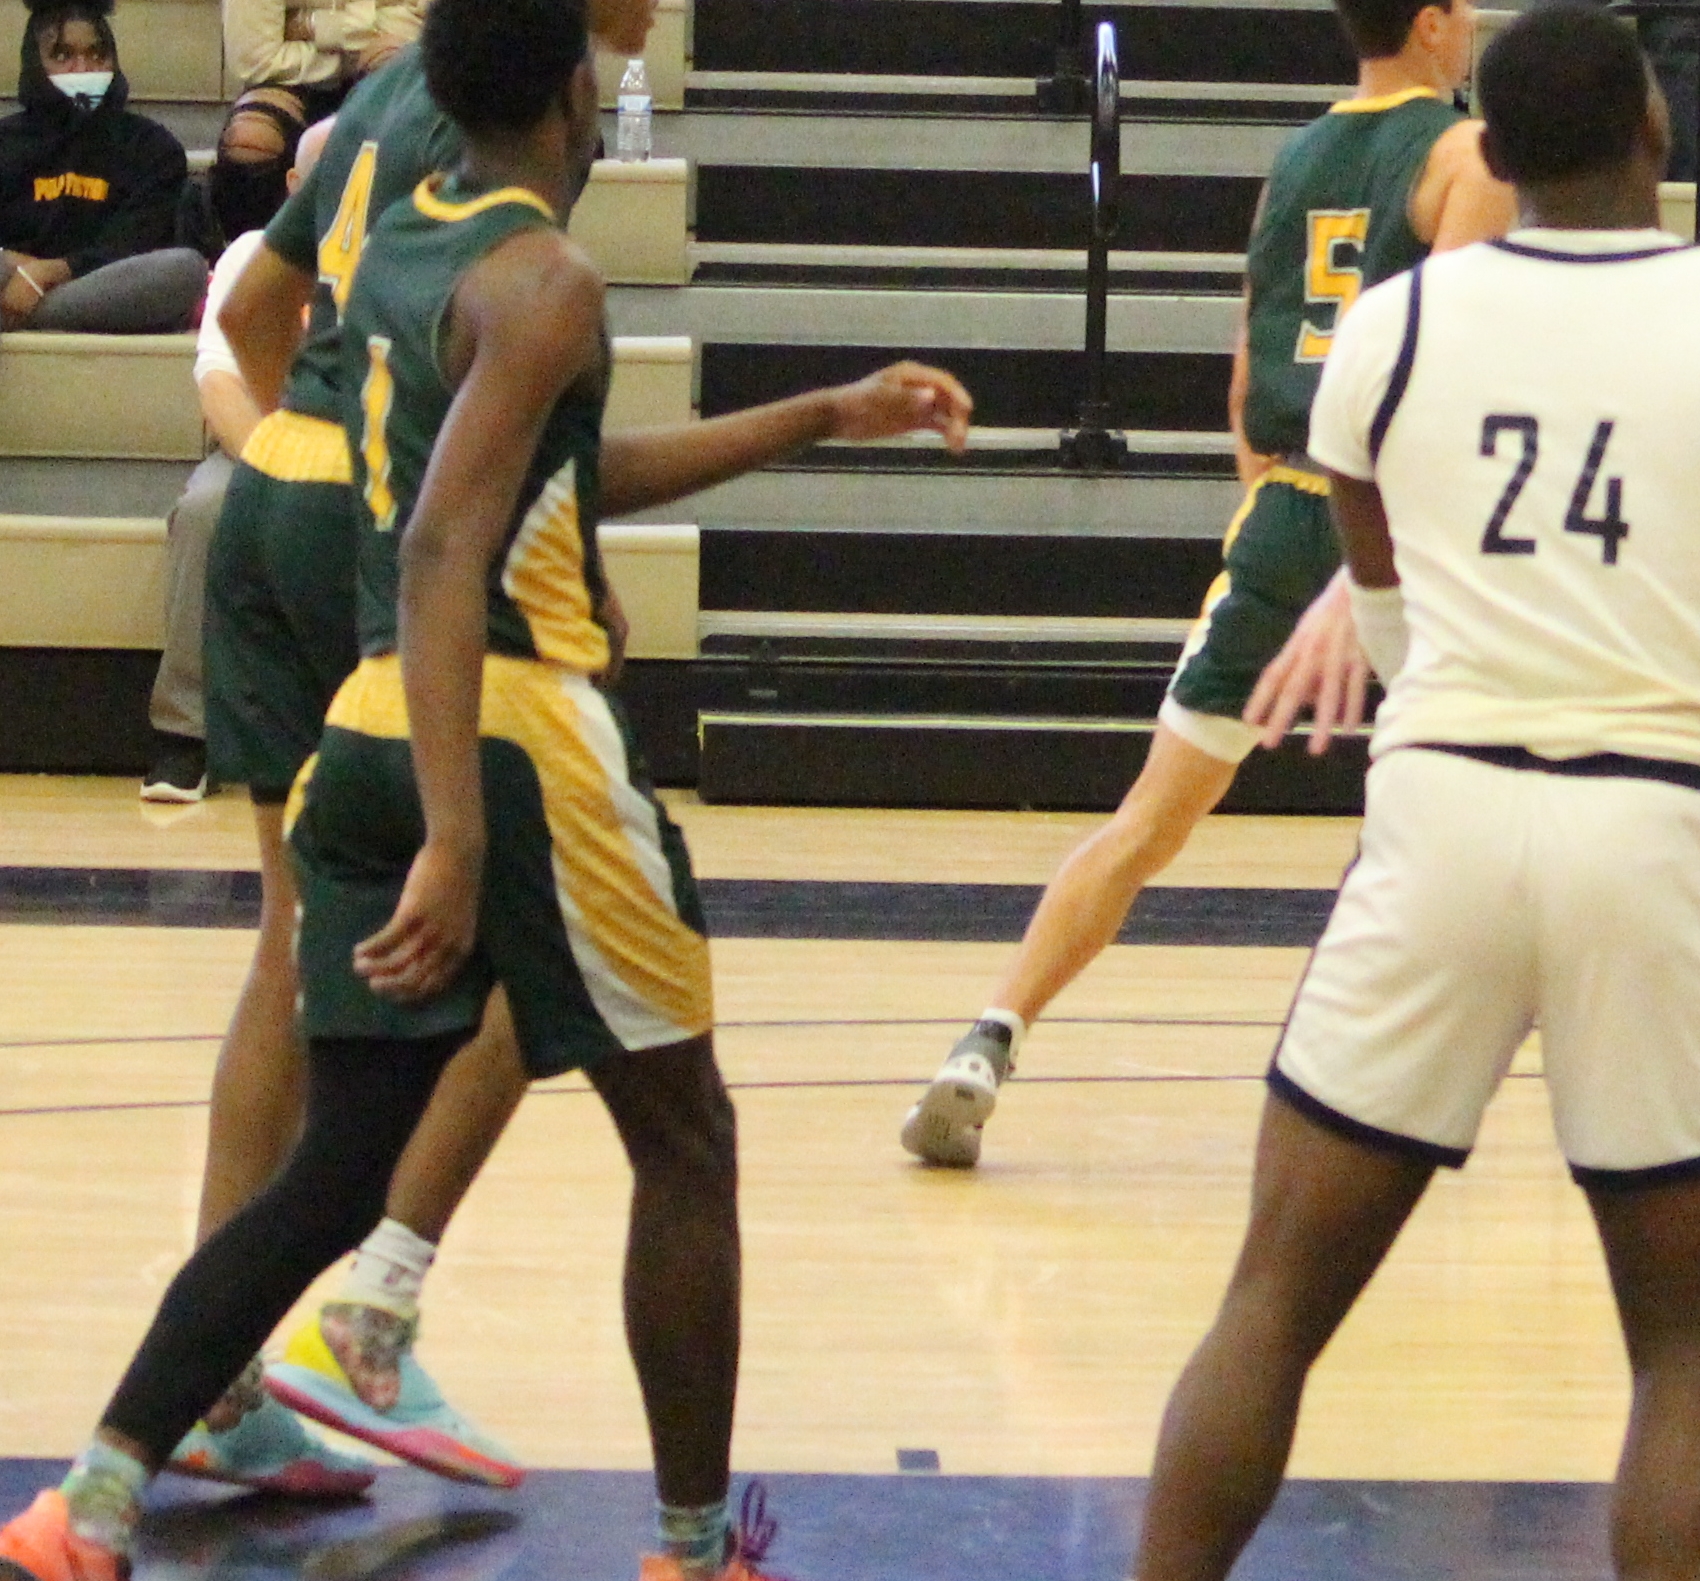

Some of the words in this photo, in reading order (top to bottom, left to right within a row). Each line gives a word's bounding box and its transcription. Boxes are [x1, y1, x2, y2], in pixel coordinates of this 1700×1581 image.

[317, 140, 379, 327] 4
[1293, 206, 1372, 364] 5
[1480, 414, 1630, 565] 24
